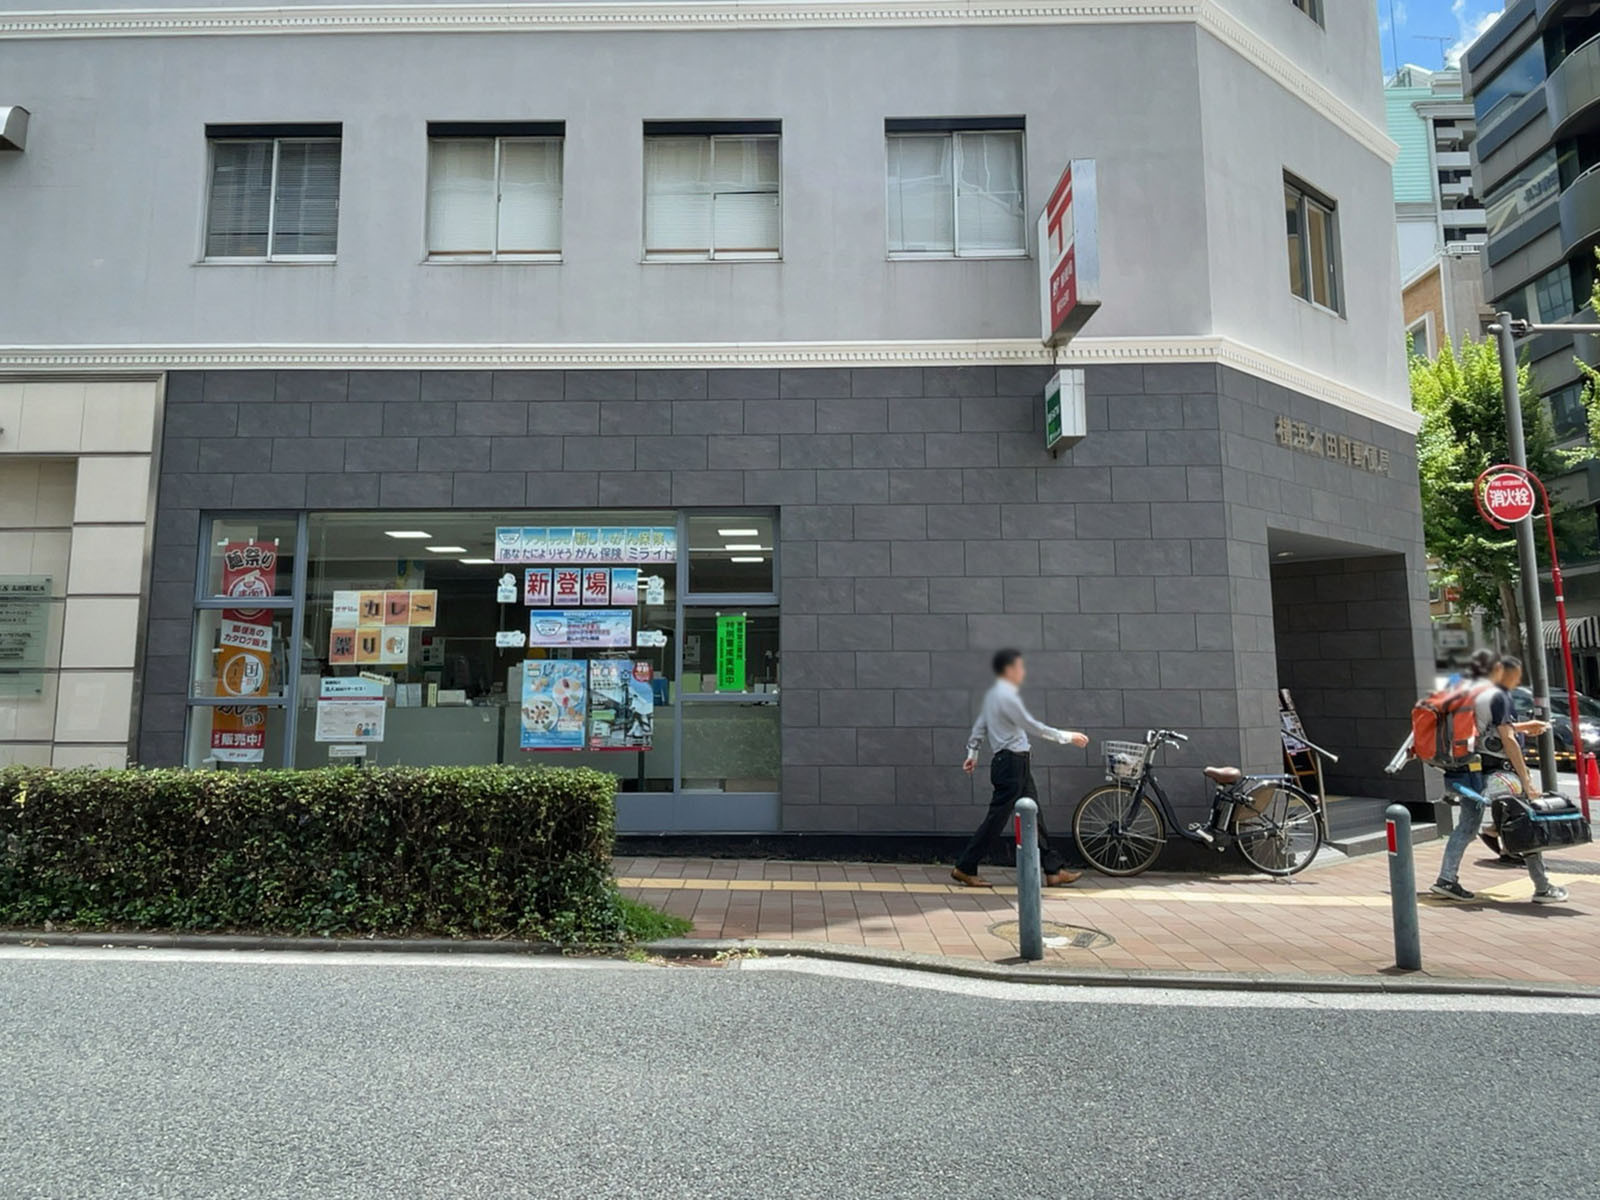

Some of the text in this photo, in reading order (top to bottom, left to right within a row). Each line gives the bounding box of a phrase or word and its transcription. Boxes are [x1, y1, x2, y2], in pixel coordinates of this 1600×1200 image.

[1489, 487, 1531, 508] 消火栓
[527, 571, 608, 596] 新登場
[363, 599, 432, 618] カレー
[335, 635, 376, 656] 祭り
